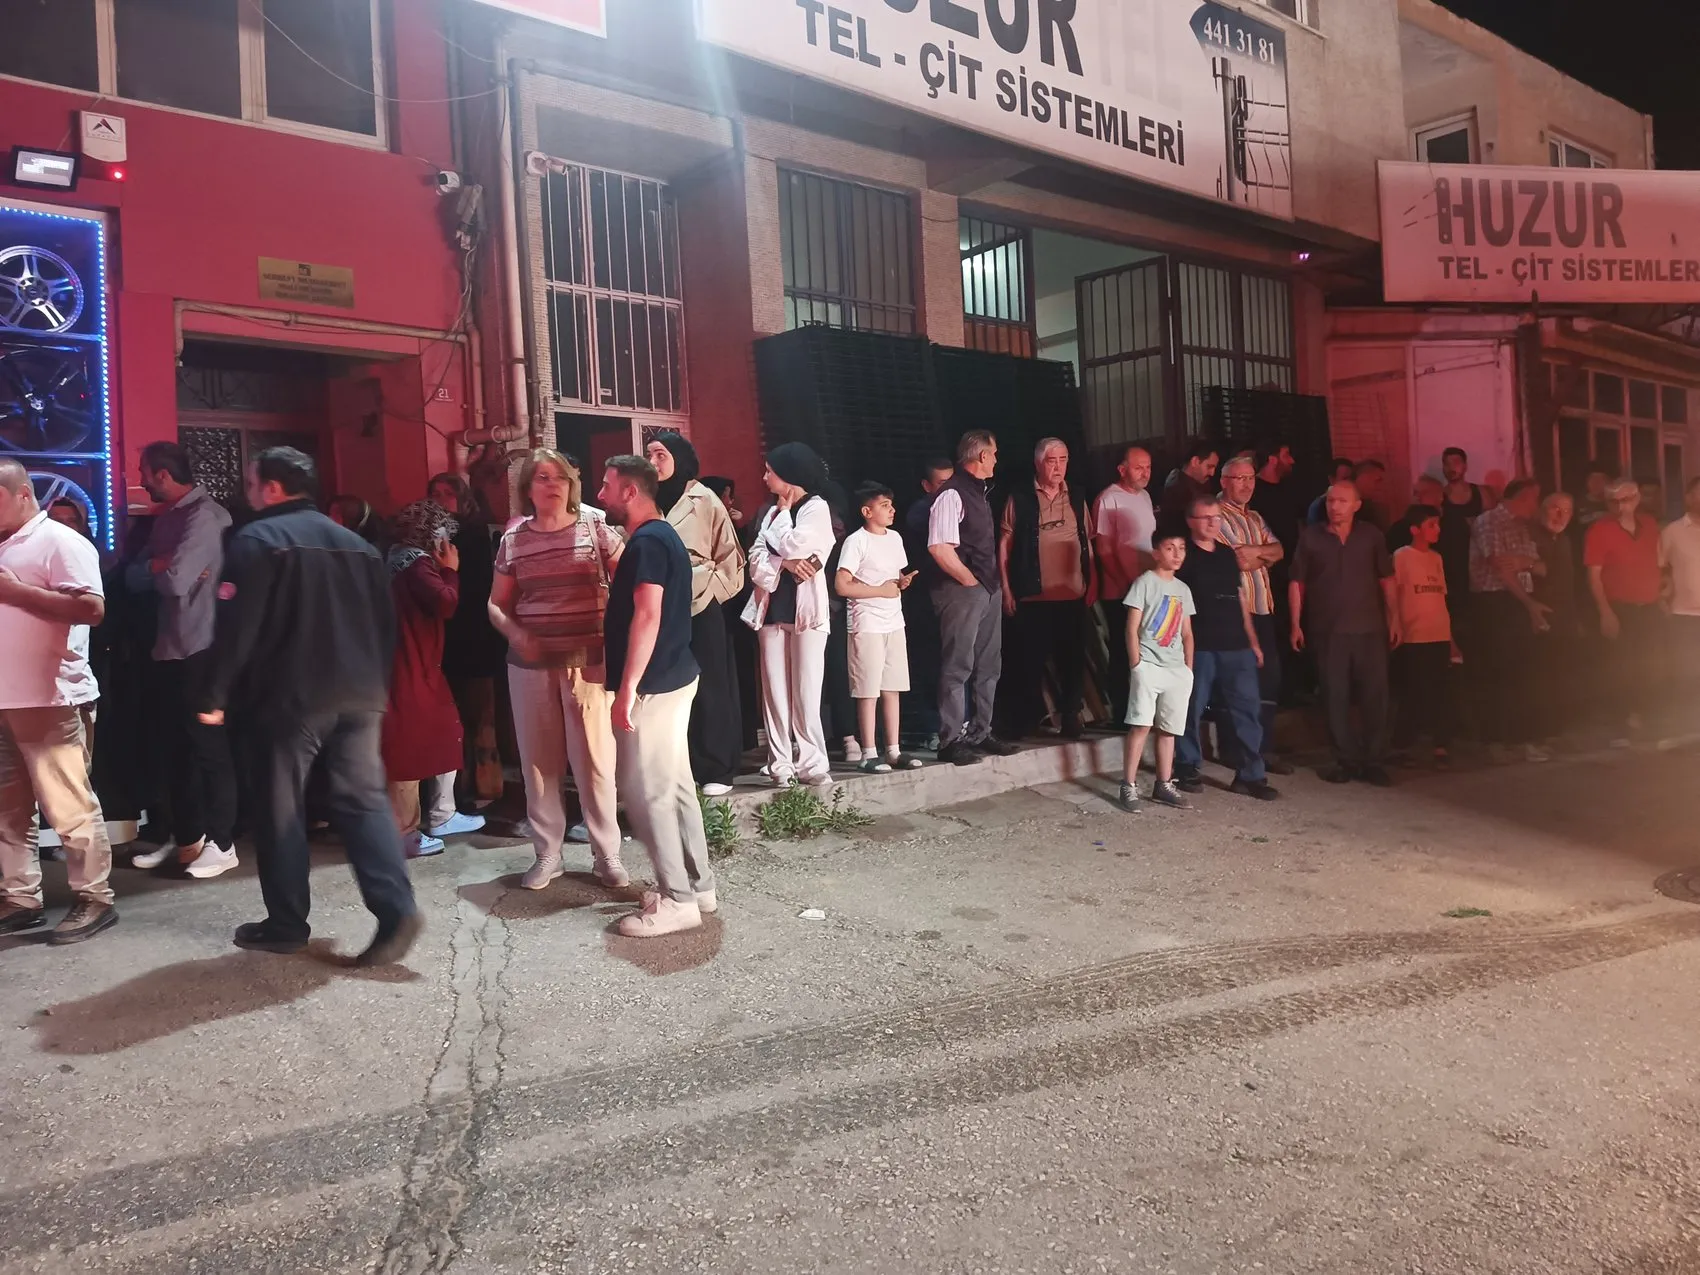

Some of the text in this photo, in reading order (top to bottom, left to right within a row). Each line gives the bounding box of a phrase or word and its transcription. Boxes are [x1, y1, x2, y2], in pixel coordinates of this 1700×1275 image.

[1203, 17, 1275, 65] 441 31 81
[796, 0, 881, 68] TEL
[919, 40, 982, 100] ÇİT
[995, 65, 1185, 167] SİSTEMLERİ
[1435, 177, 1627, 248] HUZUR
[1438, 256, 1488, 280] TEL
[1512, 252, 1553, 287] ÇİT
[1562, 253, 1700, 282] SİSTEMLER
